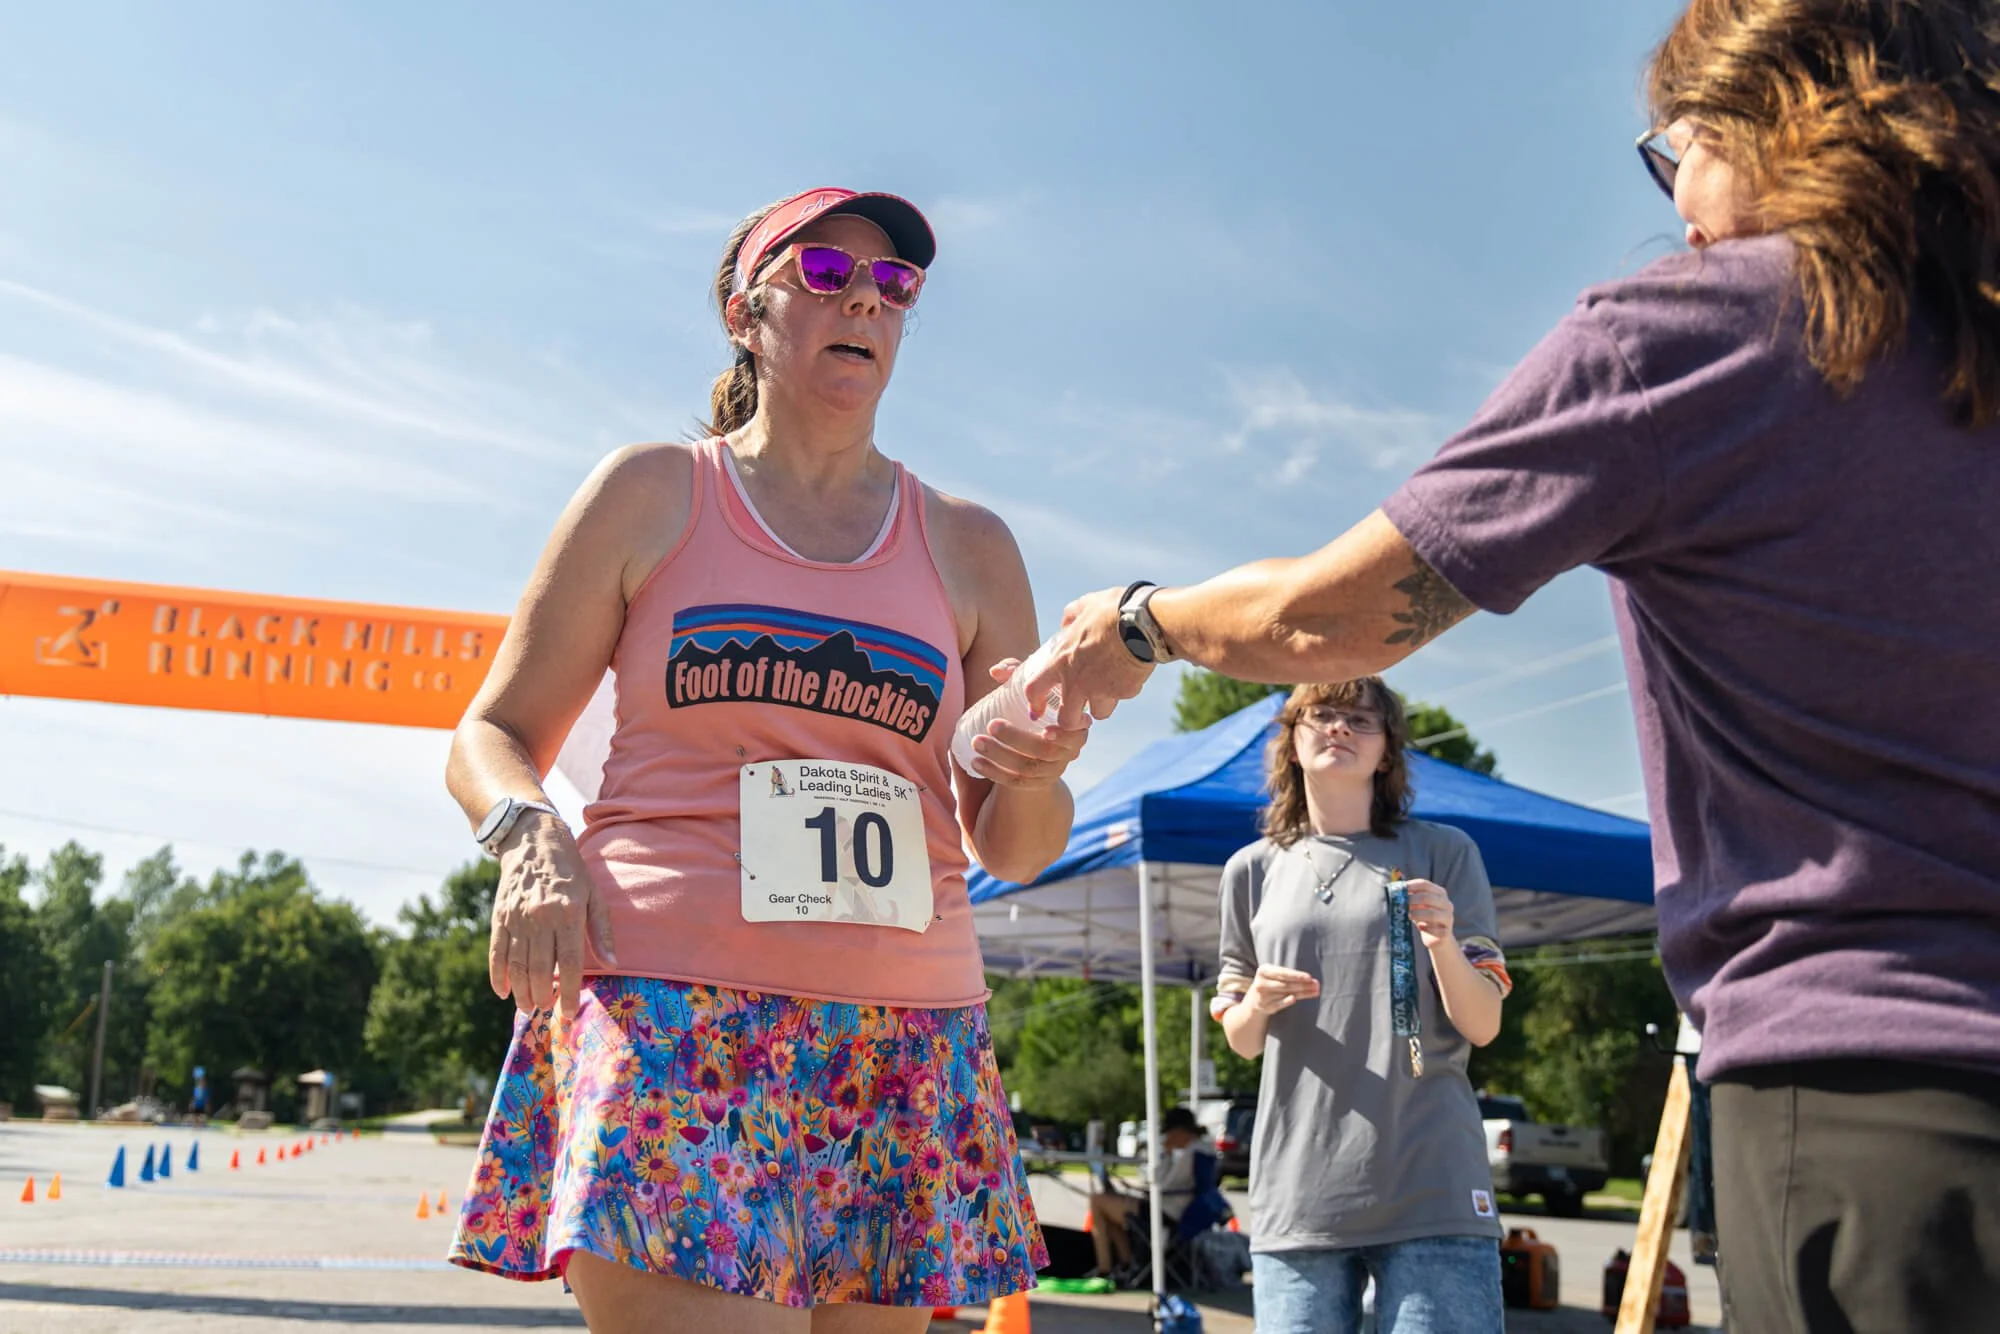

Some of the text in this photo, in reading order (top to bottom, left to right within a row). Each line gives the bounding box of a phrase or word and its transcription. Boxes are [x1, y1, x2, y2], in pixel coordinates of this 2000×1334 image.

[152, 604, 484, 661] BLACK HILLS
[149, 641, 392, 692] RUNNING
[675, 656, 930, 736] Foot of the Rockies
[799, 766, 889, 787] Dakota Spirit &
[799, 780, 852, 796] Leading
[855, 783, 892, 801] Ladies
[894, 785, 908, 800] 5K
[805, 807, 893, 888] 10
[768, 894, 832, 904] Gear Check
[795, 905, 809, 915] 10
